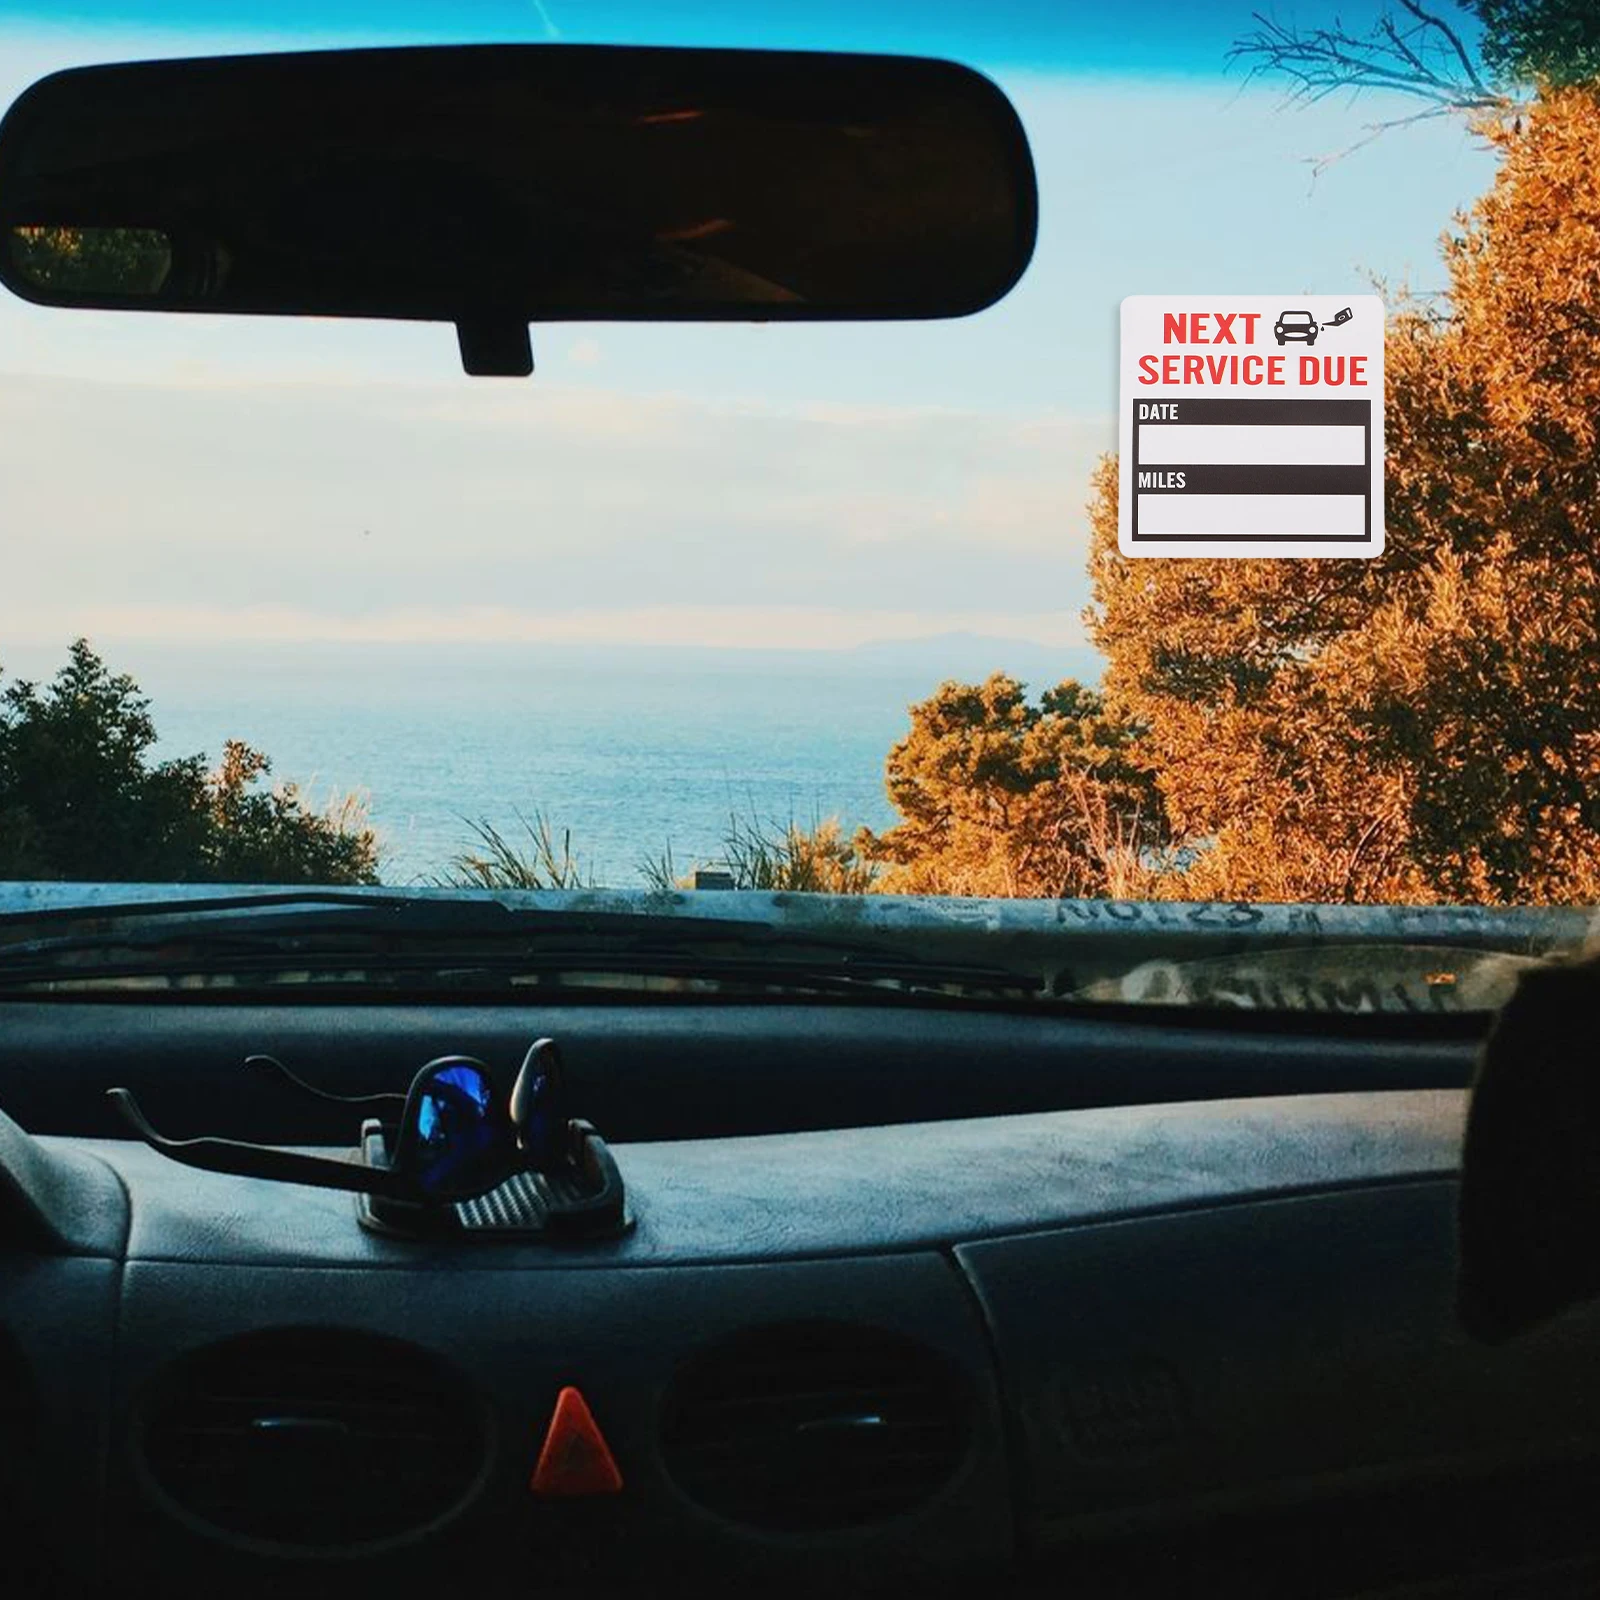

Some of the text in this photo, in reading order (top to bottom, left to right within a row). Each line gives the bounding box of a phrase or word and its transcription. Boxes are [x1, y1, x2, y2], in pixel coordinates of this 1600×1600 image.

[1164, 313, 1261, 344] NEXT
[1138, 355, 1367, 386] SERVICE DUE
[1139, 404, 1178, 419] DATE
[1139, 472, 1185, 488] MILES
